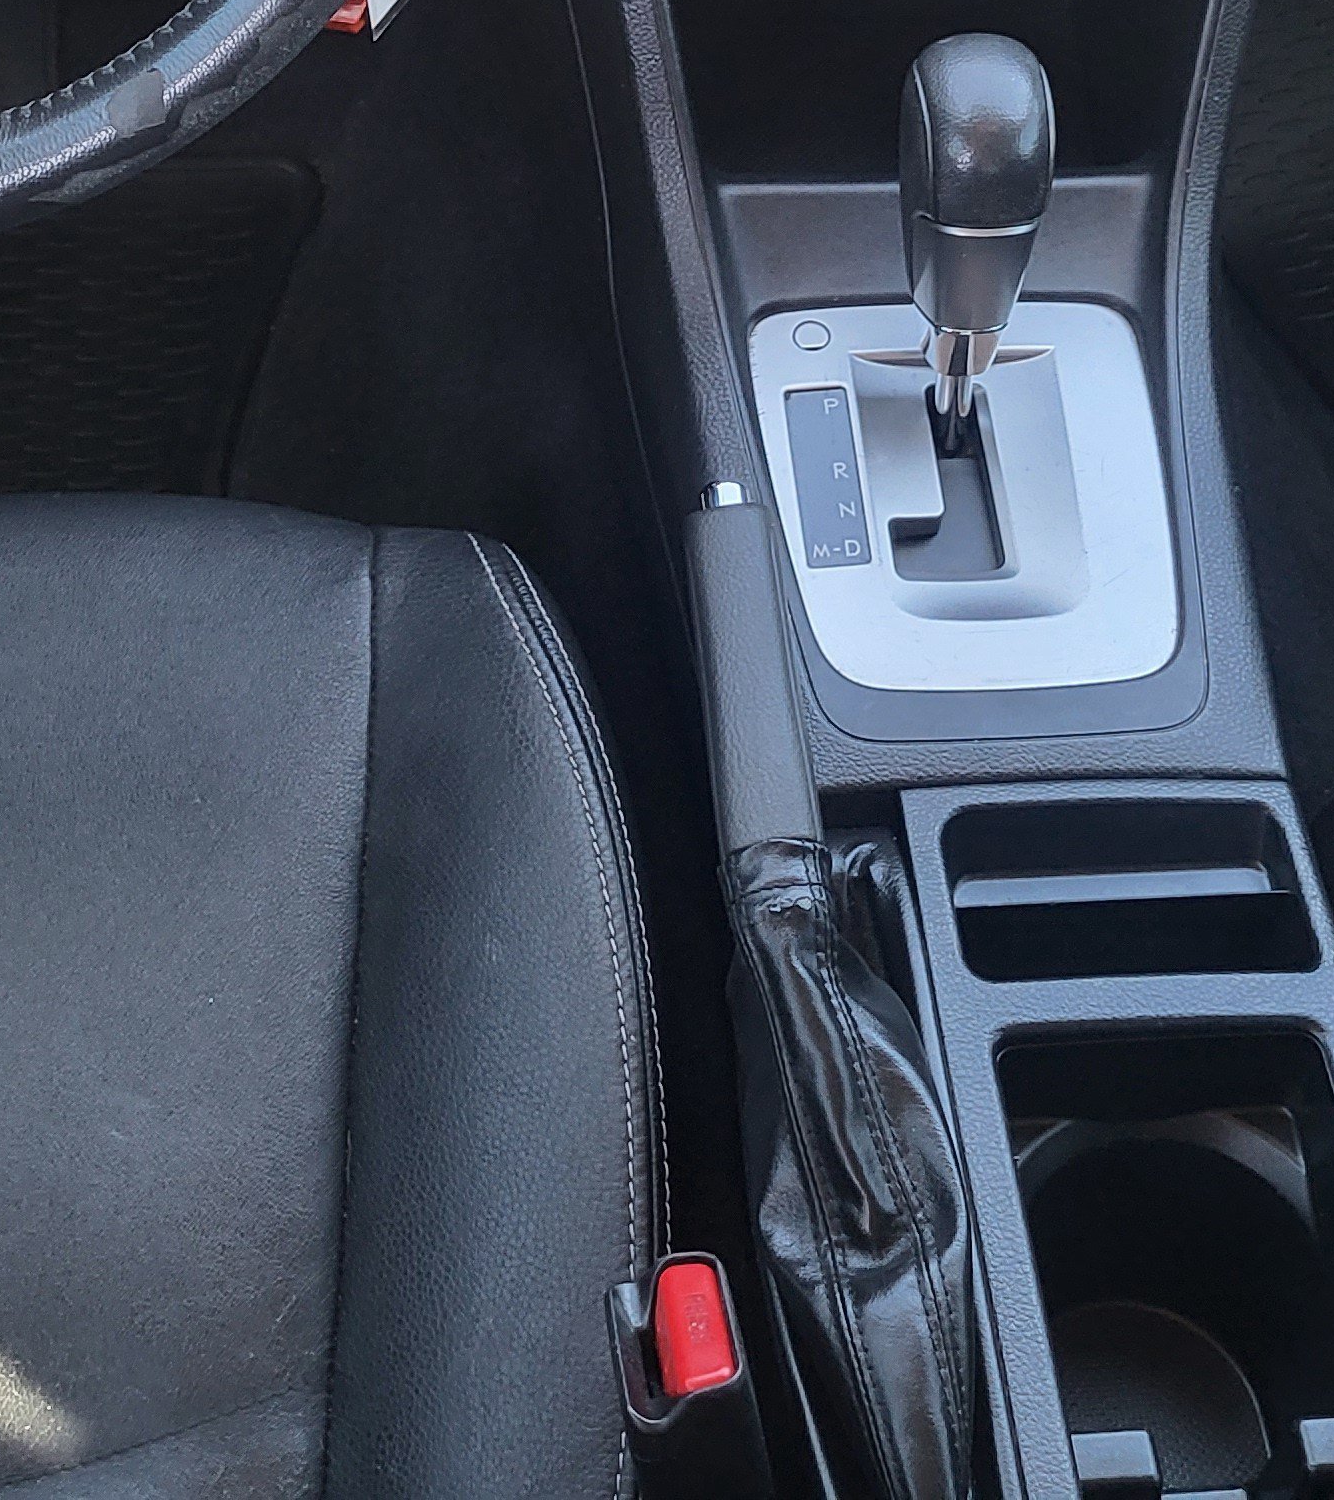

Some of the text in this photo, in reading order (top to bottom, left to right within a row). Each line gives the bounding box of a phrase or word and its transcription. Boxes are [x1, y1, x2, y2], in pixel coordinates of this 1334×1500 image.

[823, 398, 839, 415] P
[834, 462, 849, 479] R
[839, 501, 856, 518] N
